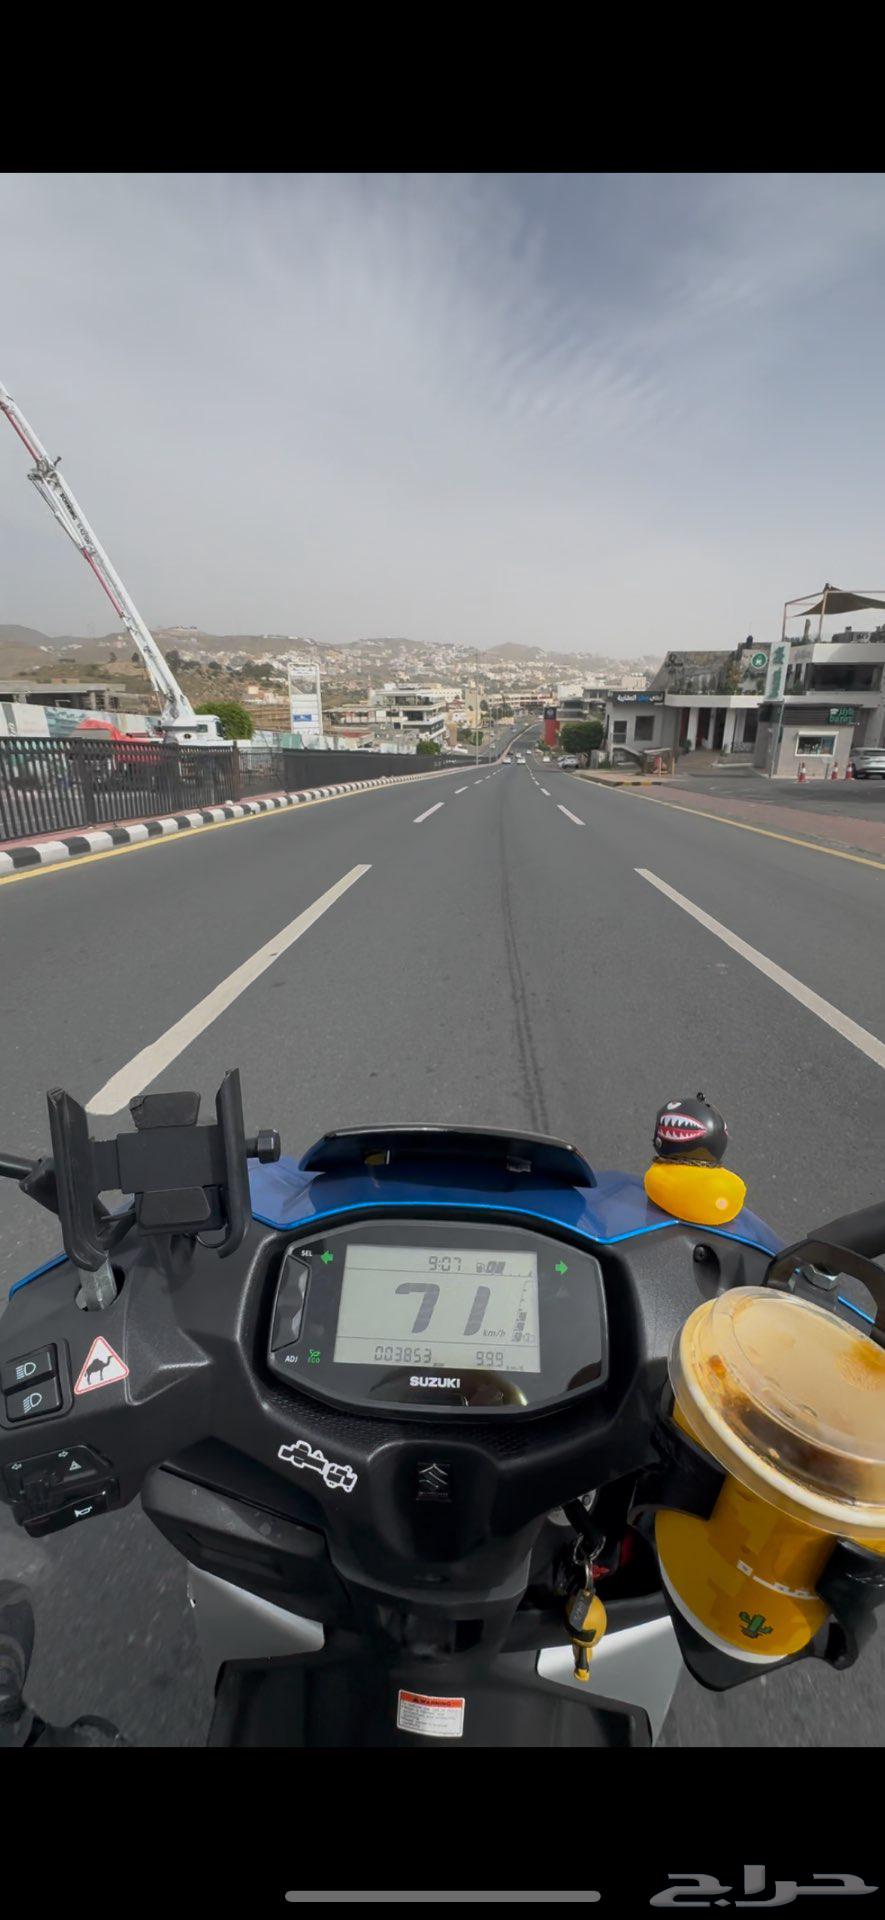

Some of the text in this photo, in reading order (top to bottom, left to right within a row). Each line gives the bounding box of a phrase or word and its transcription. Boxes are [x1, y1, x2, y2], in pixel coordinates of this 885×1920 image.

[301, 1249, 313, 1257] SEL
[429, 1256, 461, 1272] 9:07
[395, 1282, 506, 1337] 71 km/h
[284, 1355, 299, 1363] ADJ
[374, 1343, 432, 1363] 003853
[409, 1375, 461, 1388] SUZUKI
